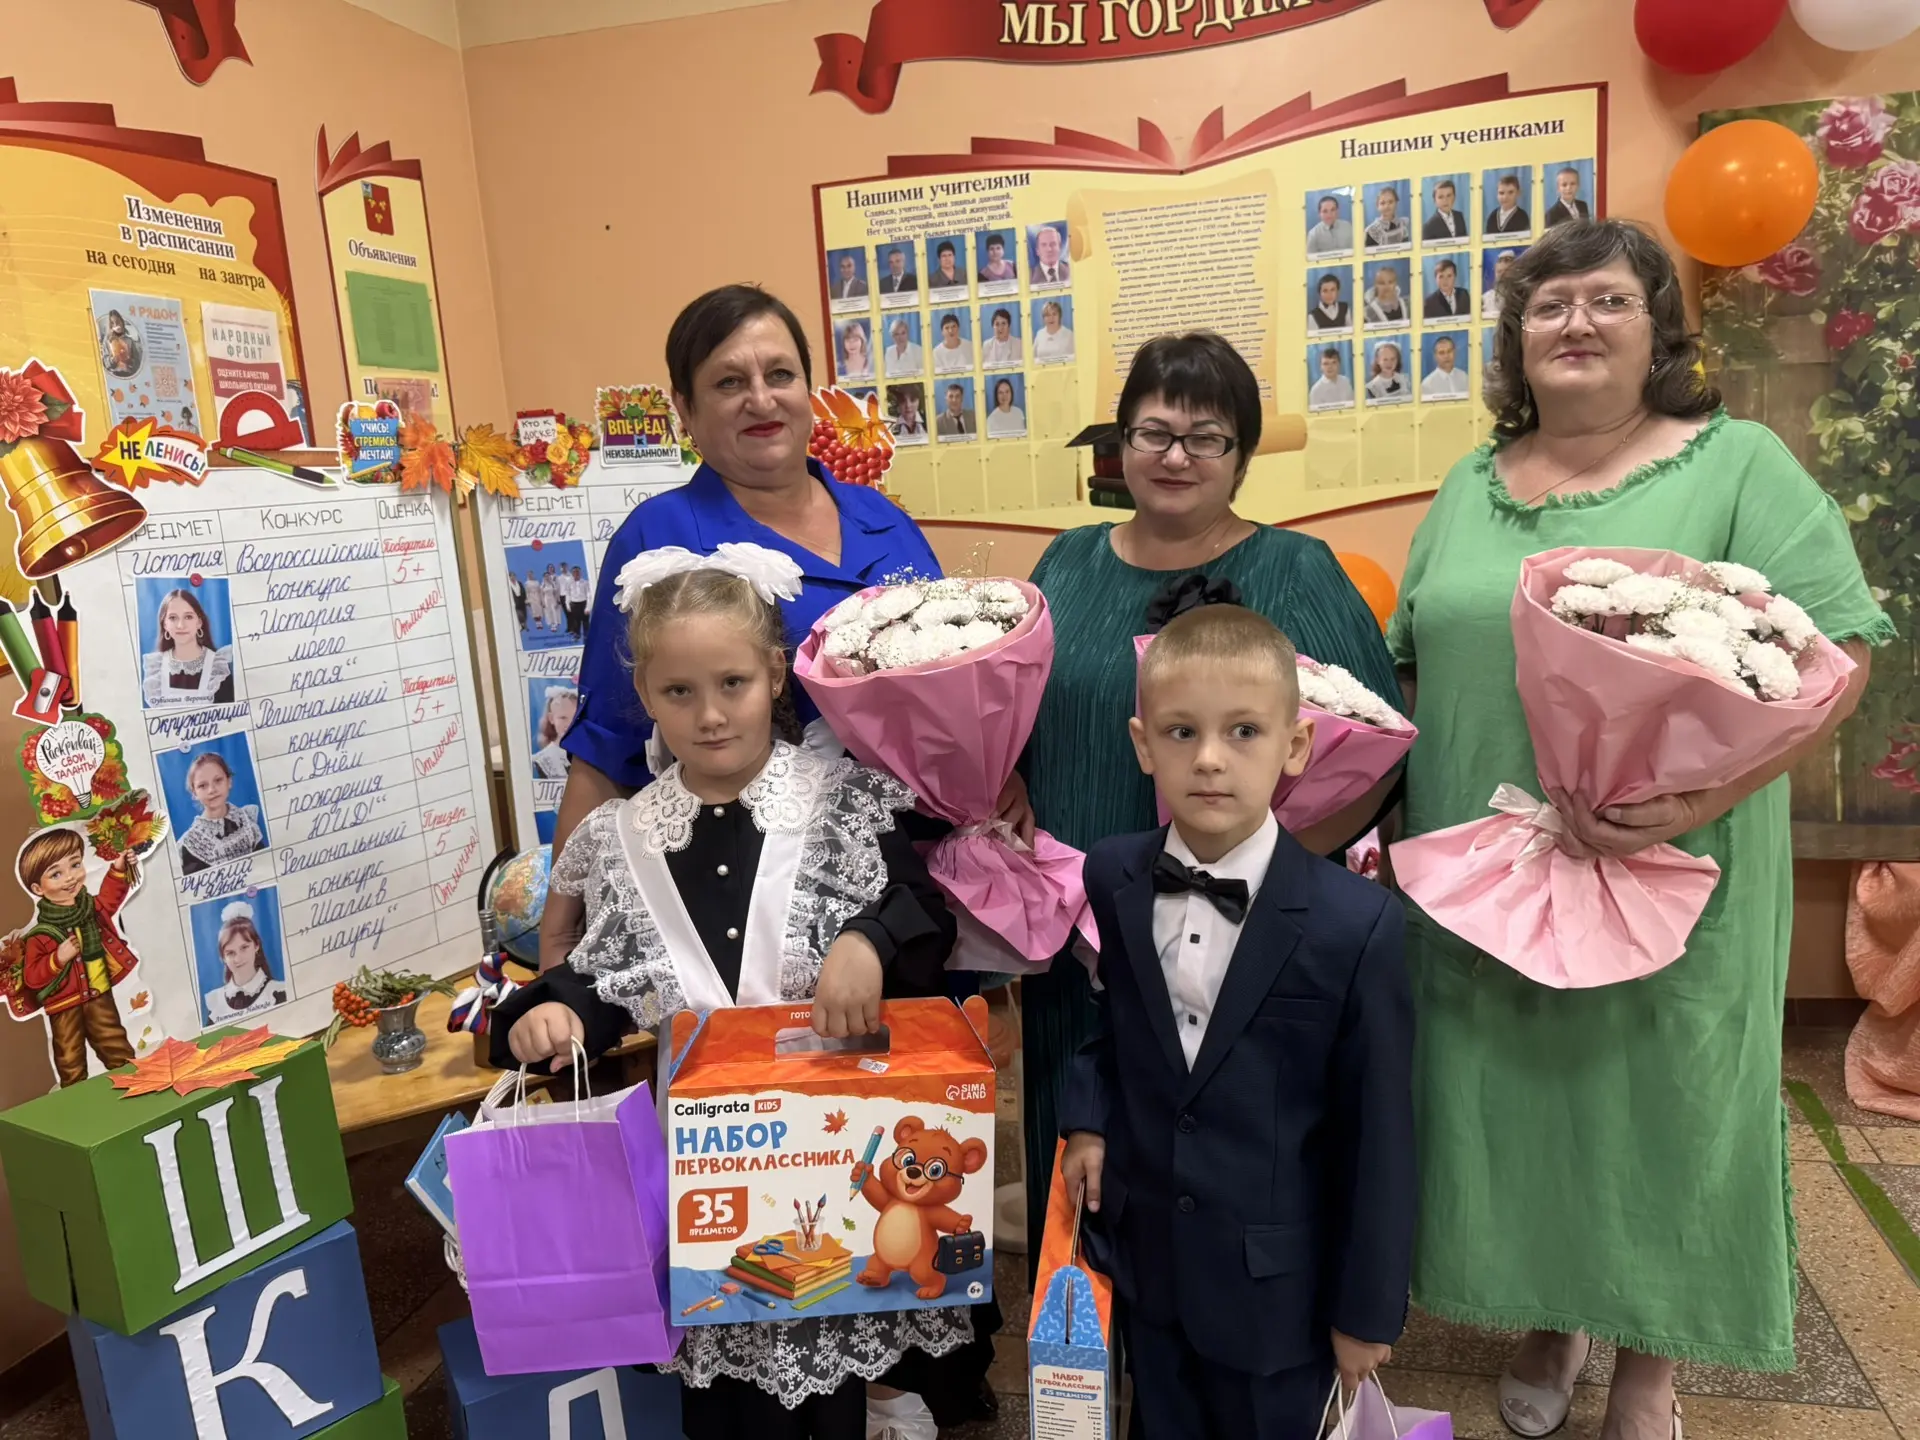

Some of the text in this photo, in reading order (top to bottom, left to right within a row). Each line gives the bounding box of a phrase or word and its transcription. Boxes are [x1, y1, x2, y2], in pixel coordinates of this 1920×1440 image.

[1000, 2, 1086, 46] МЫ
[1340, 118, 1565, 159] Нашими учениками
[846, 172, 1031, 209] Нашими учителями
[126, 196, 223, 236] Изменения
[120, 224, 236, 259] в расписании
[348, 238, 418, 268] Объявления
[85, 249, 176, 275] на сегодня
[199, 266, 266, 291] на завтра
[212, 327, 271, 346] НАРОДНЫЙ
[227, 344, 263, 359] ФРОНТ
[360, 422, 390, 433] УЧИСЬ!
[607, 418, 667, 435] ВПЕРЁД!
[354, 436, 398, 448] СТРЕМИСЬ!
[359, 449, 394, 460] МЕЧТАЙ!
[605, 448, 678, 459] НЕИЗВЕДАННОМУ!
[636, 437, 644, 445] К
[120, 440, 206, 475] НЕ ЛЕНИСЬ!
[130, 518, 214, 542] РЕДМЕТ
[504, 516, 577, 540] Театр
[132, 536, 436, 583] История Всероссийский Победитель
[267, 574, 352, 602] конкурс
[288, 578, 444, 663] моего Отлично!
[524, 651, 580, 677] Труд
[256, 675, 457, 730] Региональный Победитель
[149, 701, 250, 739] Окружающий
[181, 723, 220, 742] мир
[40, 728, 97, 765] Раскрывай
[288, 718, 368, 755] конкурс
[54, 761, 98, 780] ТАЛАНТЫ!
[61, 752, 86, 768] СВОИ
[286, 715, 462, 831] рождения Отлично!
[309, 750, 364, 780] Днём
[279, 820, 408, 877] Региональный
[203, 828, 451, 900] язык конкурс 5
[433, 827, 480, 906] Отлично!
[960, 1083, 986, 1093] SIMA
[960, 1091, 987, 1100] LAND
[674, 1100, 750, 1118] Calligrata
[945, 1112, 963, 1124] 2+2
[675, 1120, 788, 1155] НАБОР
[674, 1148, 855, 1176] ПЕРВОКЛАССНИКА
[142, 1073, 311, 1294] Ш
[692, 1192, 735, 1226] 35
[689, 1225, 739, 1237] ПРЕДМЕТОВ
[969, 1286, 981, 1295] 6+
[158, 1266, 334, 1440] К
[1035, 1378, 1102, 1391] ПЕРВОКЛАССНИКА
[1052, 1372, 1084, 1382] НАБОР
